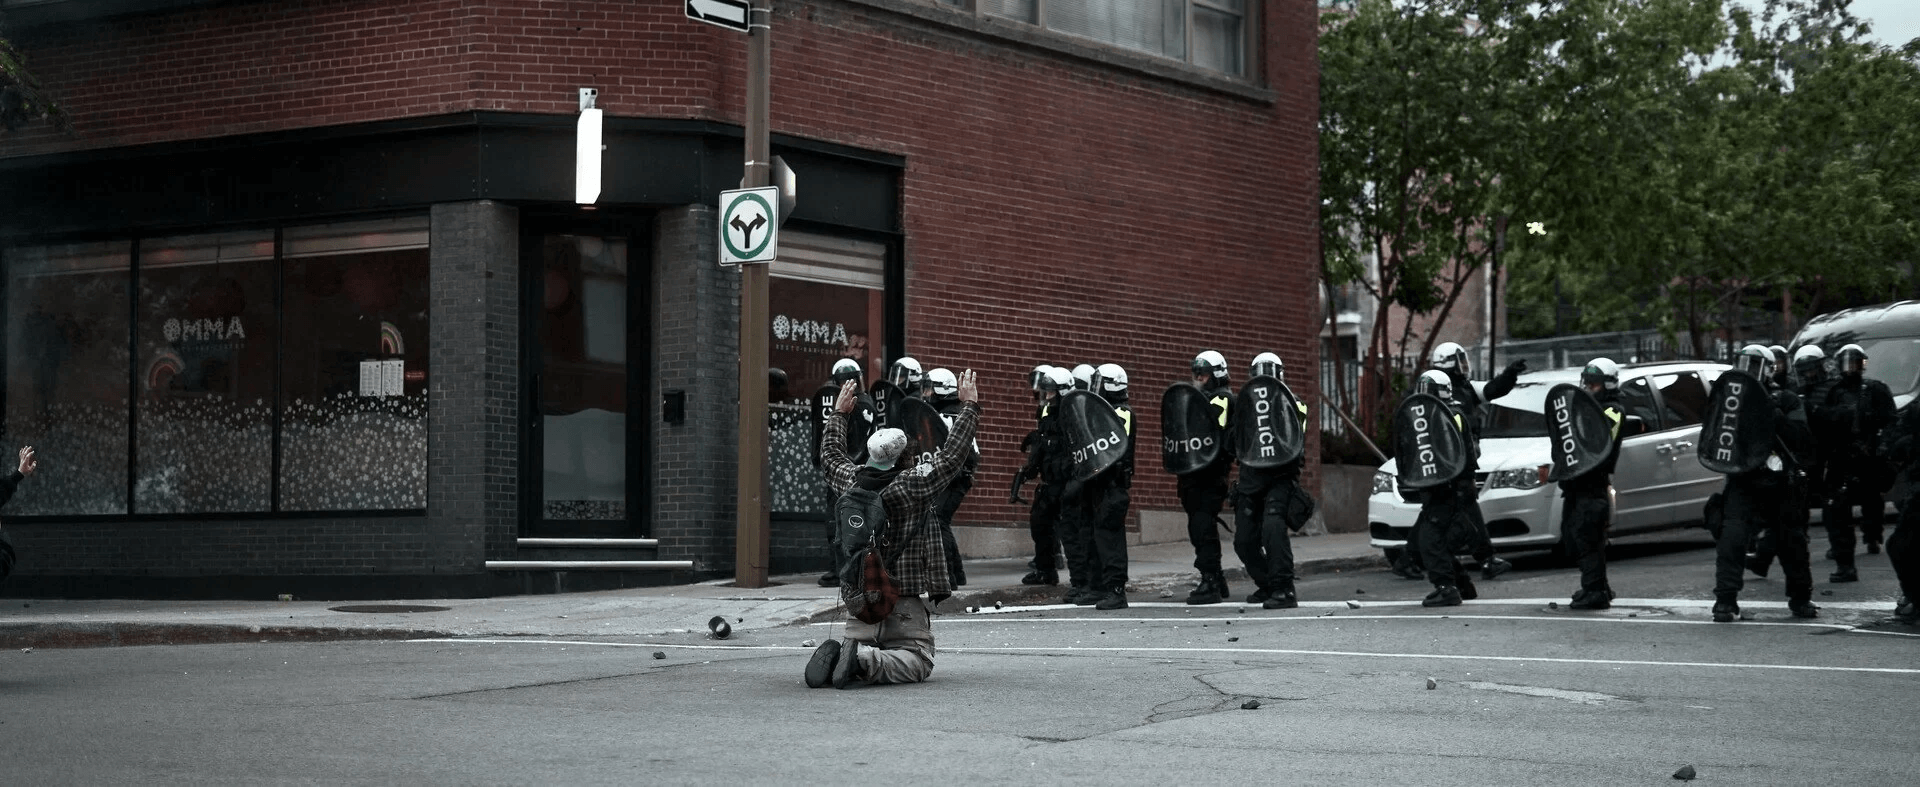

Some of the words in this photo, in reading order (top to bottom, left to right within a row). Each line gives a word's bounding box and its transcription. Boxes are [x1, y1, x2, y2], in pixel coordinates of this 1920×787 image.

[163, 316, 246, 342] OMMA
[772, 314, 849, 346] OMMA
[875, 388, 887, 428] LICE
[1253, 386, 1275, 458] POLICE
[1410, 404, 1437, 477] POLICE
[1553, 395, 1579, 467] POLICE
[1716, 382, 1742, 462] POLICE
